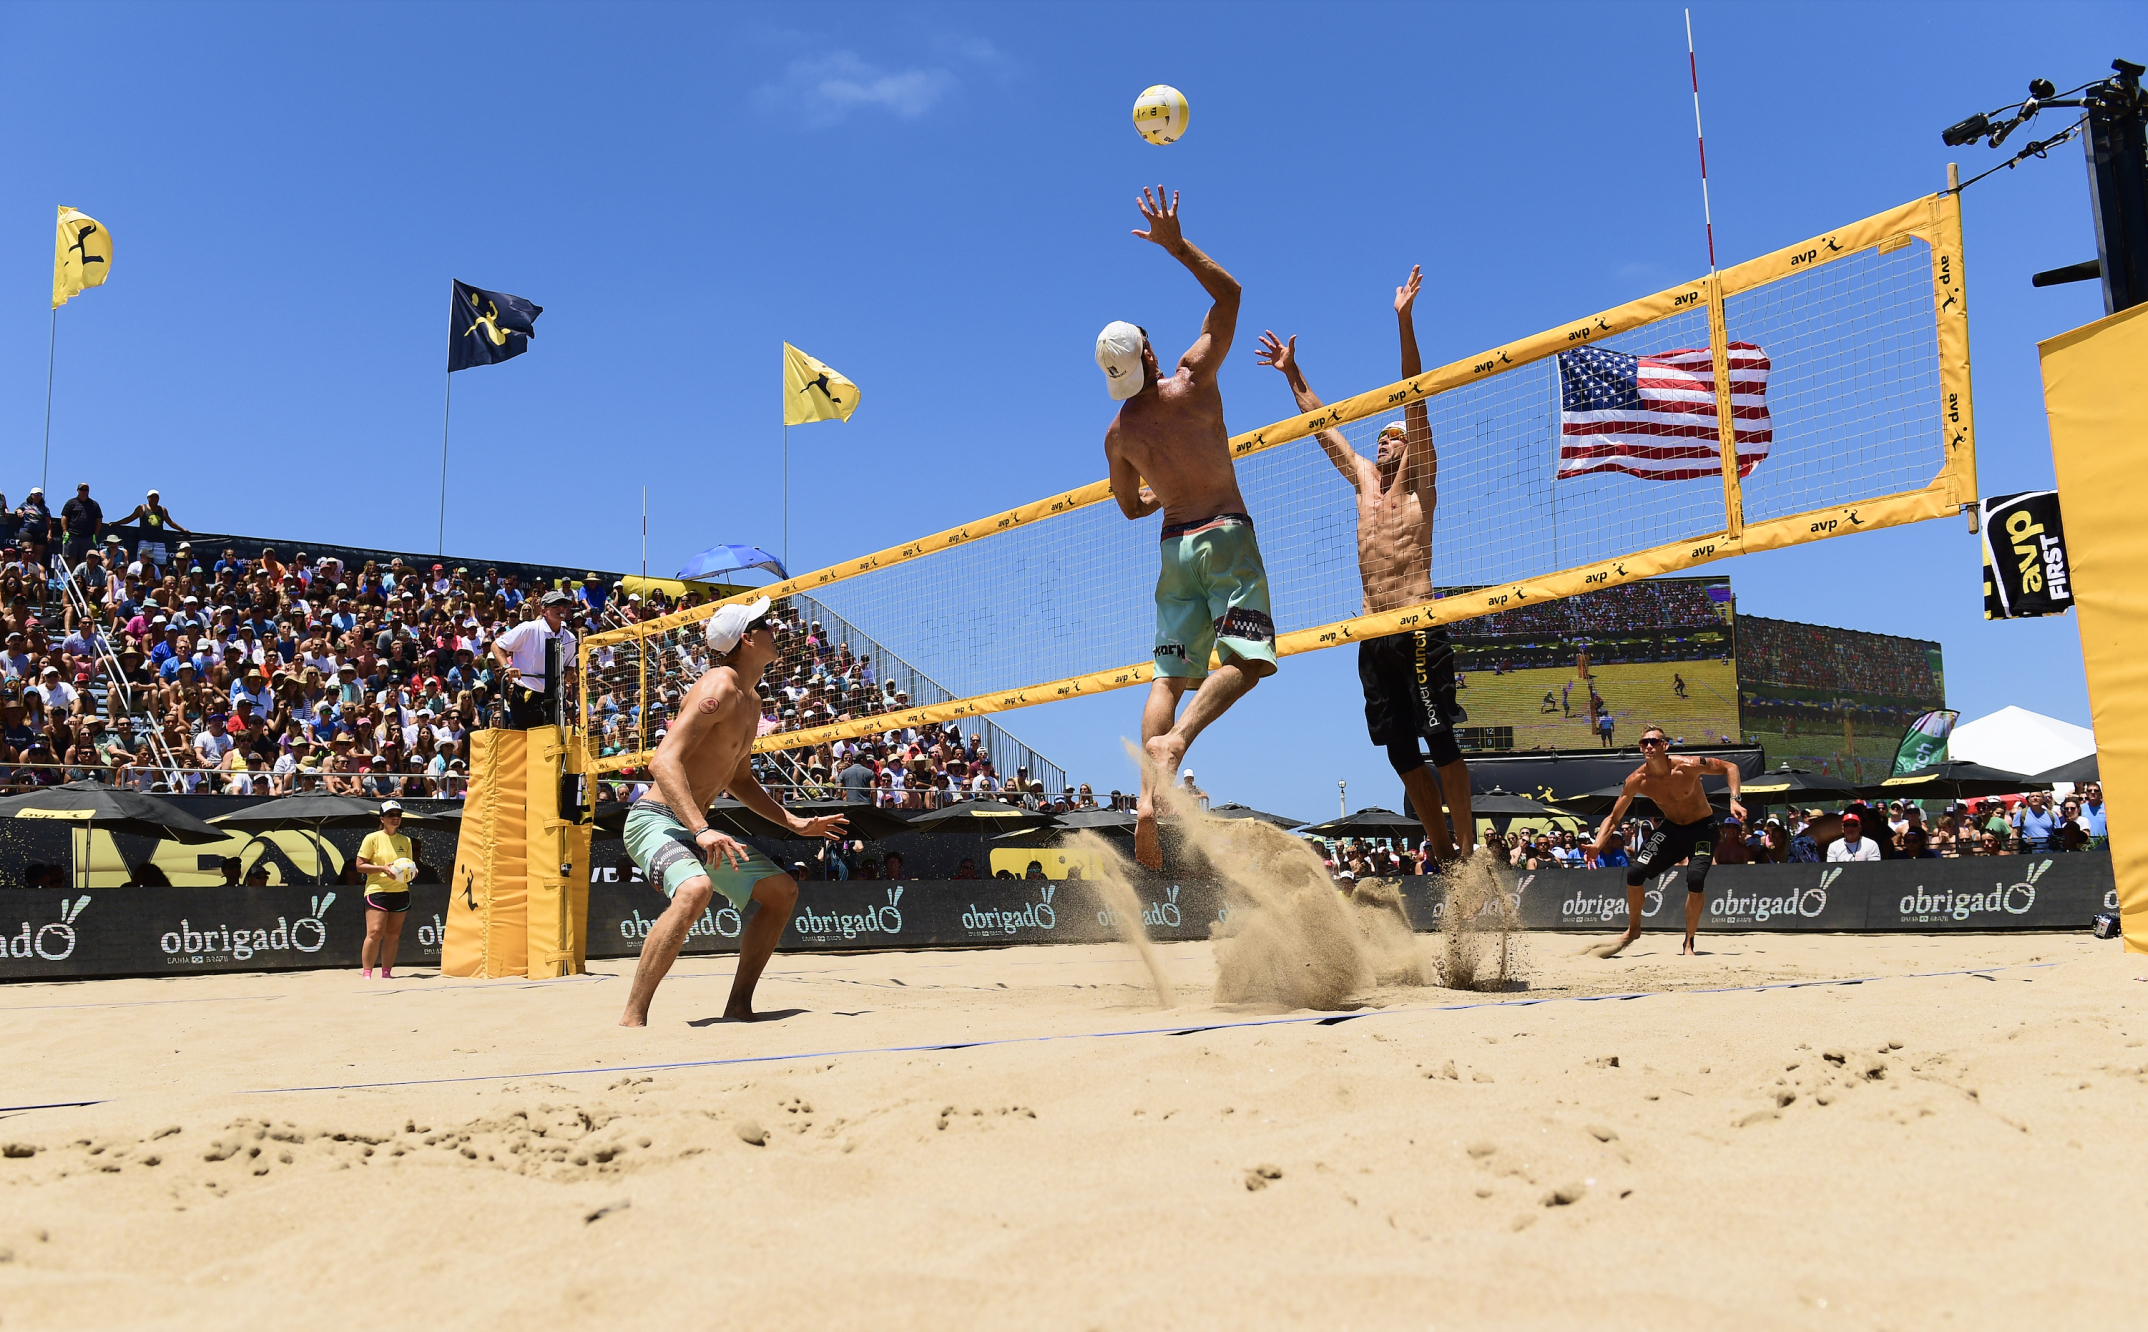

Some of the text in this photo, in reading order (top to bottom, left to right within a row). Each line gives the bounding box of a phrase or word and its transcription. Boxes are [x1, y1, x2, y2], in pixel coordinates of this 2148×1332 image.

[1791, 249, 1817, 265] avp
[1939, 255, 1950, 285] avp
[1674, 290, 1698, 306] avp
[1568, 326, 1590, 341] avp
[1474, 360, 1494, 374] avp
[1388, 390, 1406, 403] avp
[1948, 393, 1959, 422] avp
[1308, 416, 1326, 429] avp
[1236, 440, 1252, 452] avp
[1051, 501, 1063, 512] avp
[998, 518, 1010, 528] avp
[1810, 519, 1838, 532] avp
[949, 534, 959, 543] avp
[903, 548, 913, 557] avp
[1691, 543, 1715, 558] avp
[2006, 510, 2044, 594] avp
[860, 561, 870, 570] avp
[2040, 534, 2070, 600] FIRST
[1585, 570, 1608, 584] avp
[1488, 594, 1508, 606] avp
[1400, 613, 1419, 625] avp
[1319, 632, 1336, 642] avp
[1115, 674, 1128, 684] avp
[1058, 686, 1070, 695] avp
[1004, 696, 1016, 706] avp
[954, 705, 965, 714] avp
[907, 714, 918, 723] avp
